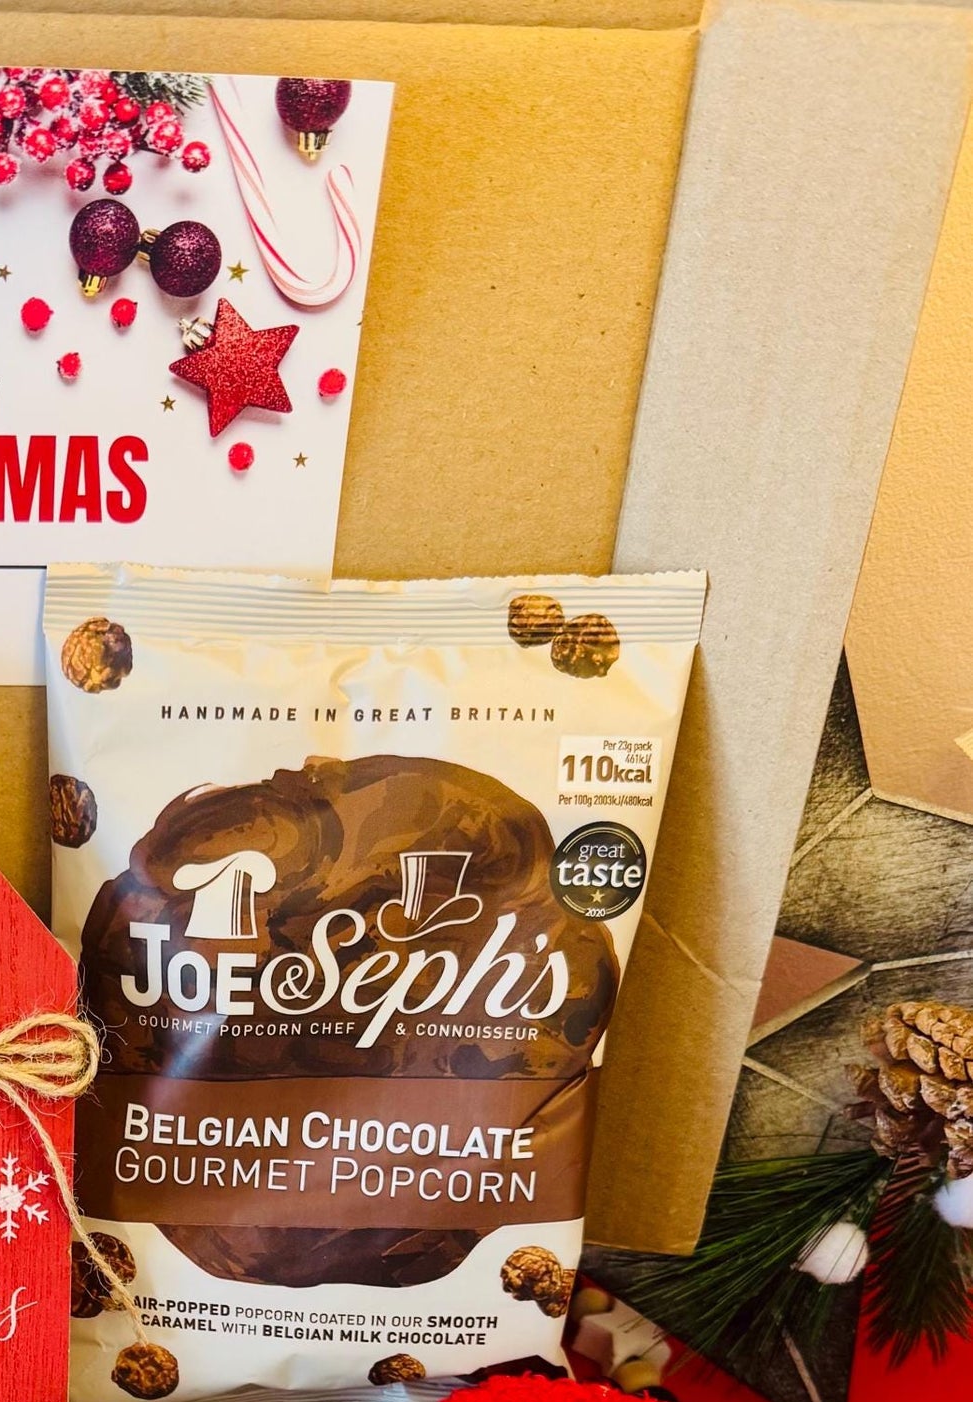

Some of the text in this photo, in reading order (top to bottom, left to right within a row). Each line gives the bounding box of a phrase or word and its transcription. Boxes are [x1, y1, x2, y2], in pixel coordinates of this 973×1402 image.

[161, 705, 556, 723] HANDMADE IN GREAT BRITAIN
[602, 740, 652, 754] Per 23g pack
[558, 794, 572, 806] Per
[574, 795, 592, 808] 100g
[579, 842, 626, 863] great
[556, 859, 642, 889] taste
[585, 907, 606, 918] 2020
[120, 908, 570, 1049] JOE & Seph's
[137, 1014, 540, 1043] GOURMET POPCORN CHEF & CONNOISSEUR
[123, 1101, 535, 1160] BELGIAN CHOCOLATE
[113, 1146, 537, 1203] GOURMET POPCORN
[133, 1295, 498, 1329] AIR-POPPED POPCORN COATED IN OUR SMOOTH
[141, 1313, 487, 1346] CARAMEL WITH BELGIAN MILK CHOCOLATE
